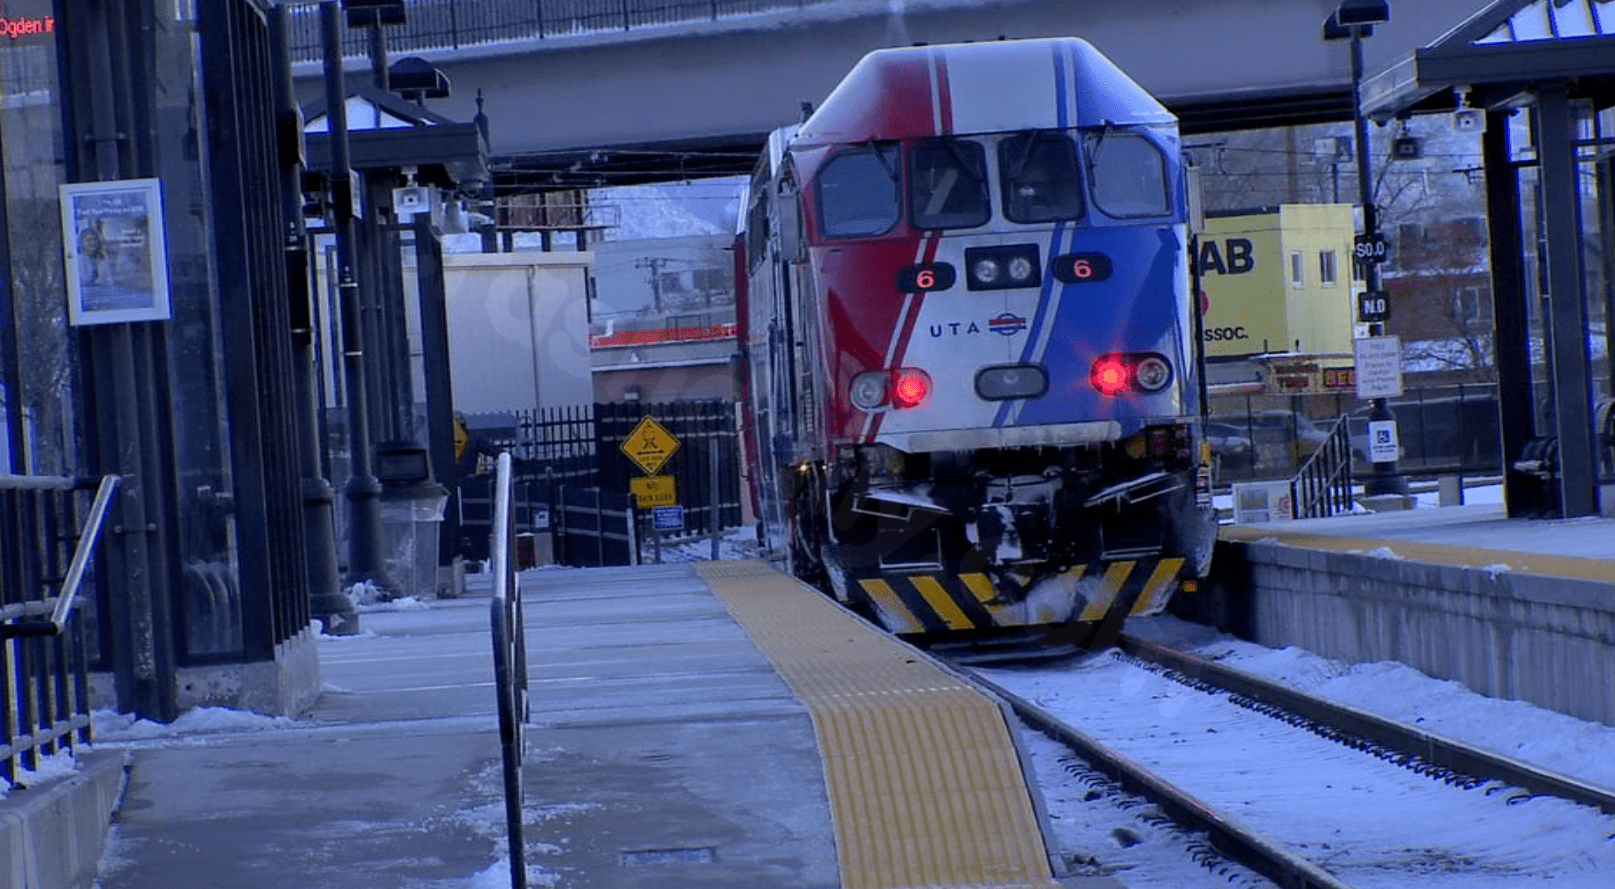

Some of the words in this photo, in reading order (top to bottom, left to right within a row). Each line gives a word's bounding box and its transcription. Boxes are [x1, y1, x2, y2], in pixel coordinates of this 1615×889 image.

[0, 17, 42, 38] Ogden
[1188, 238, 1255, 277] AB
[1073, 260, 1092, 279] 6
[916, 270, 935, 289] 6
[929, 321, 980, 339] UTA
